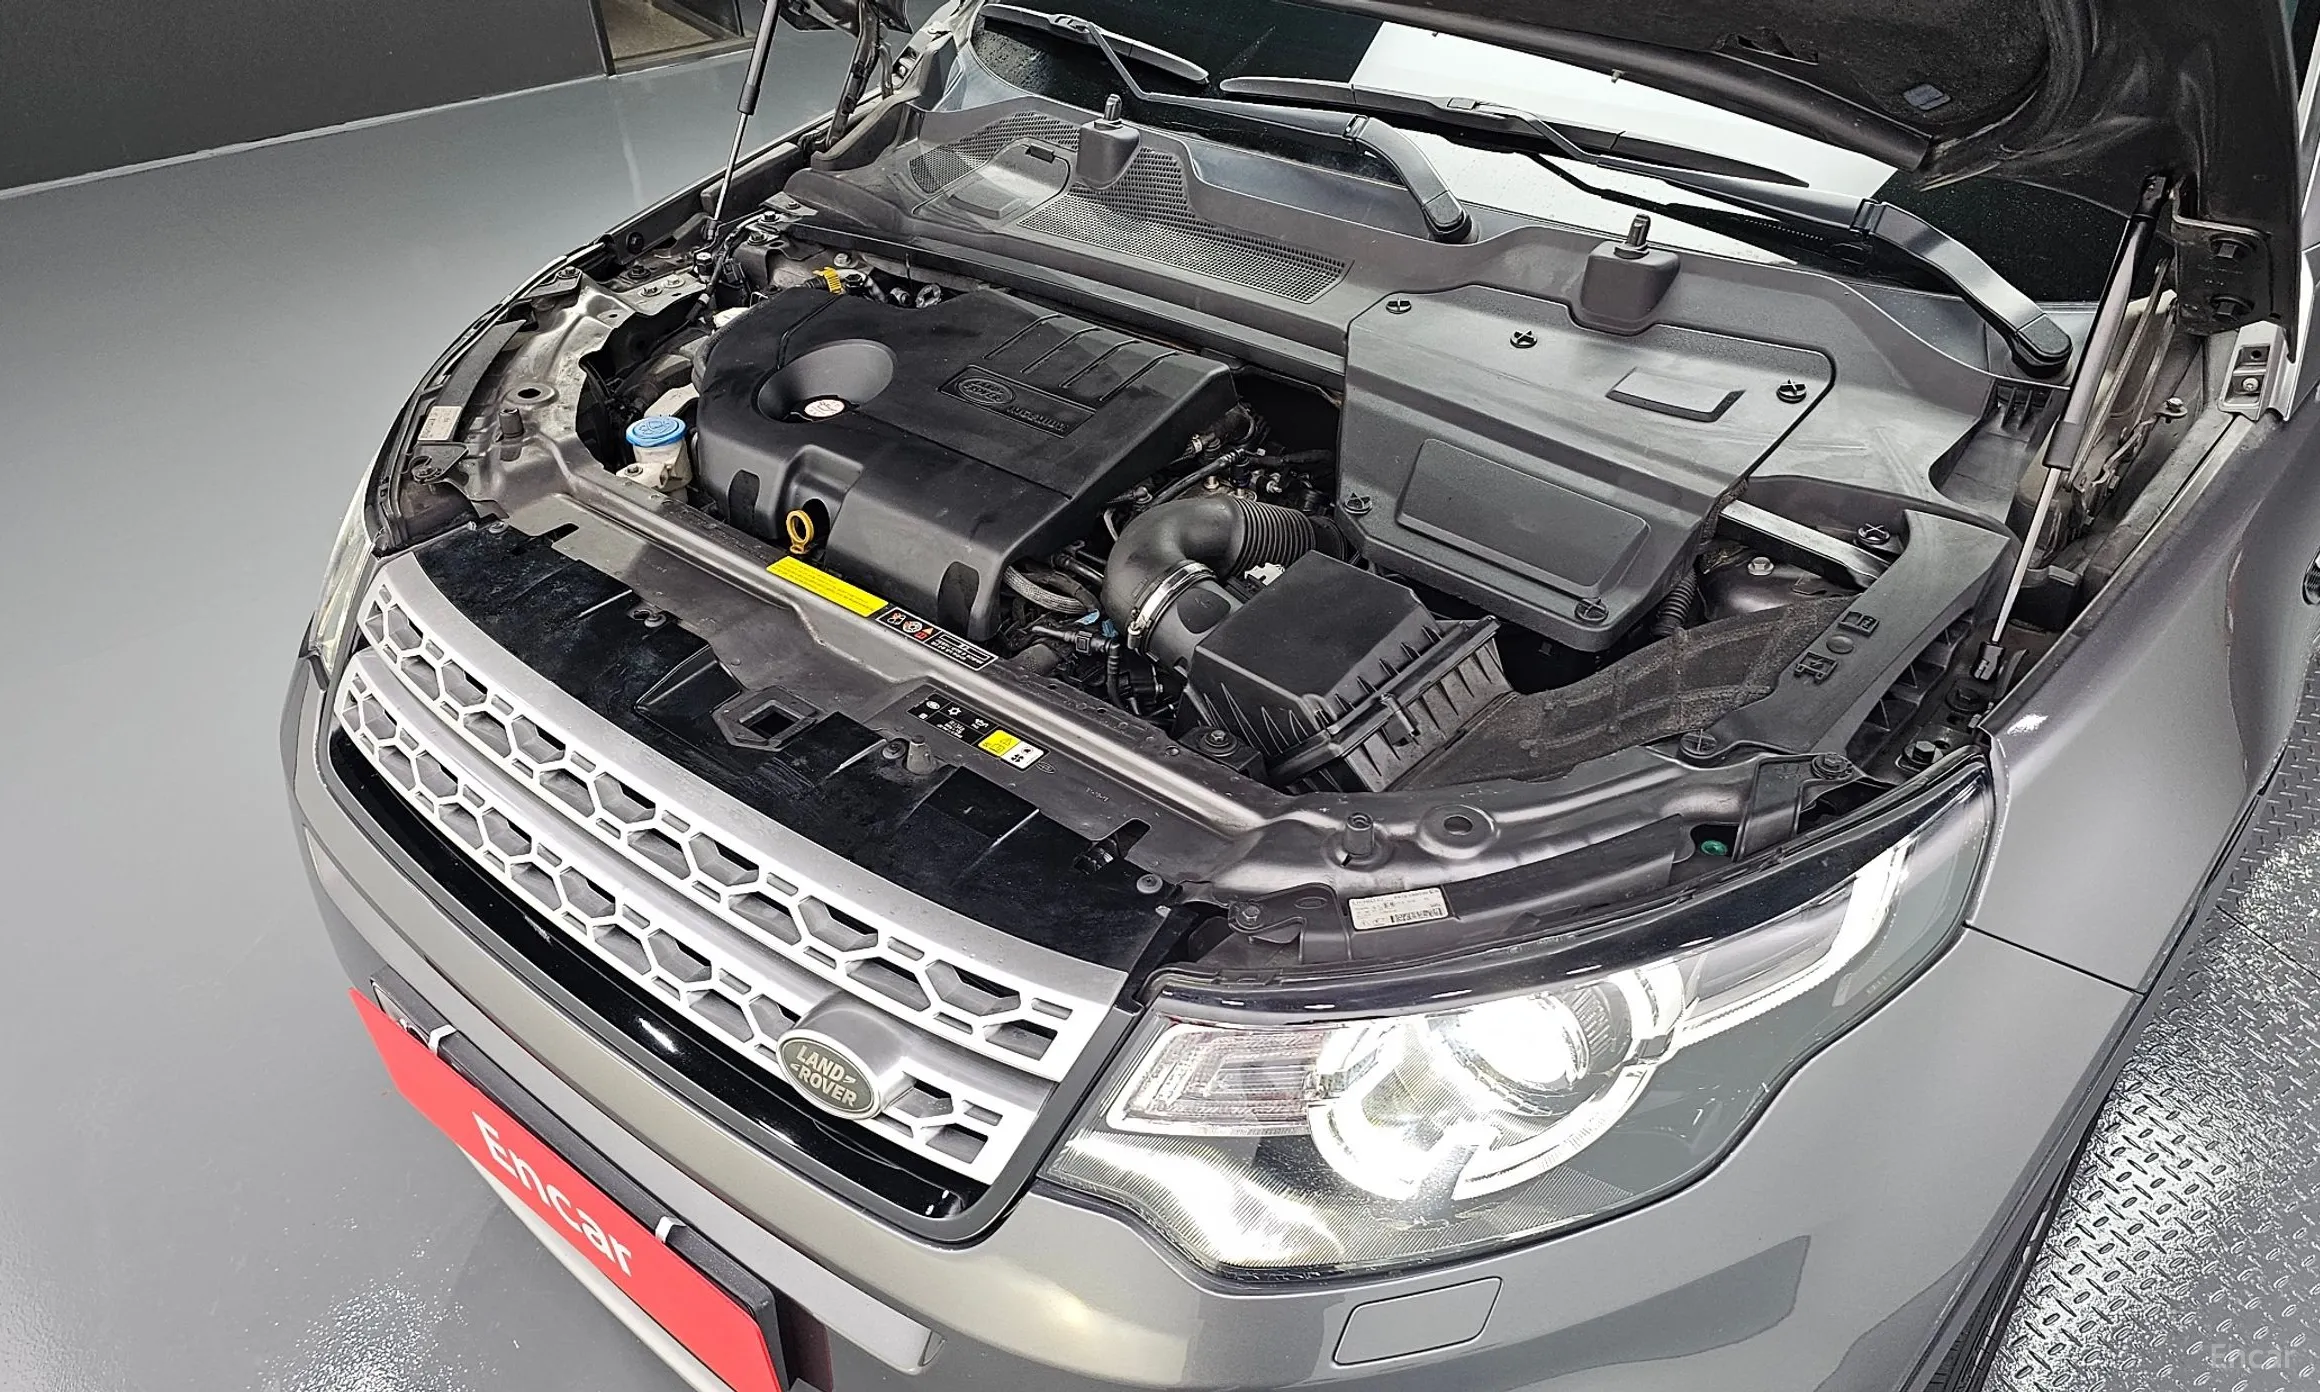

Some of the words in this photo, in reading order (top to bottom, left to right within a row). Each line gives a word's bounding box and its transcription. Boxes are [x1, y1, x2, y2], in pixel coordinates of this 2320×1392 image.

[796, 1045, 845, 1081] LAND
[798, 1064, 857, 1107] ROVER
[471, 1111, 632, 1277] Encar
